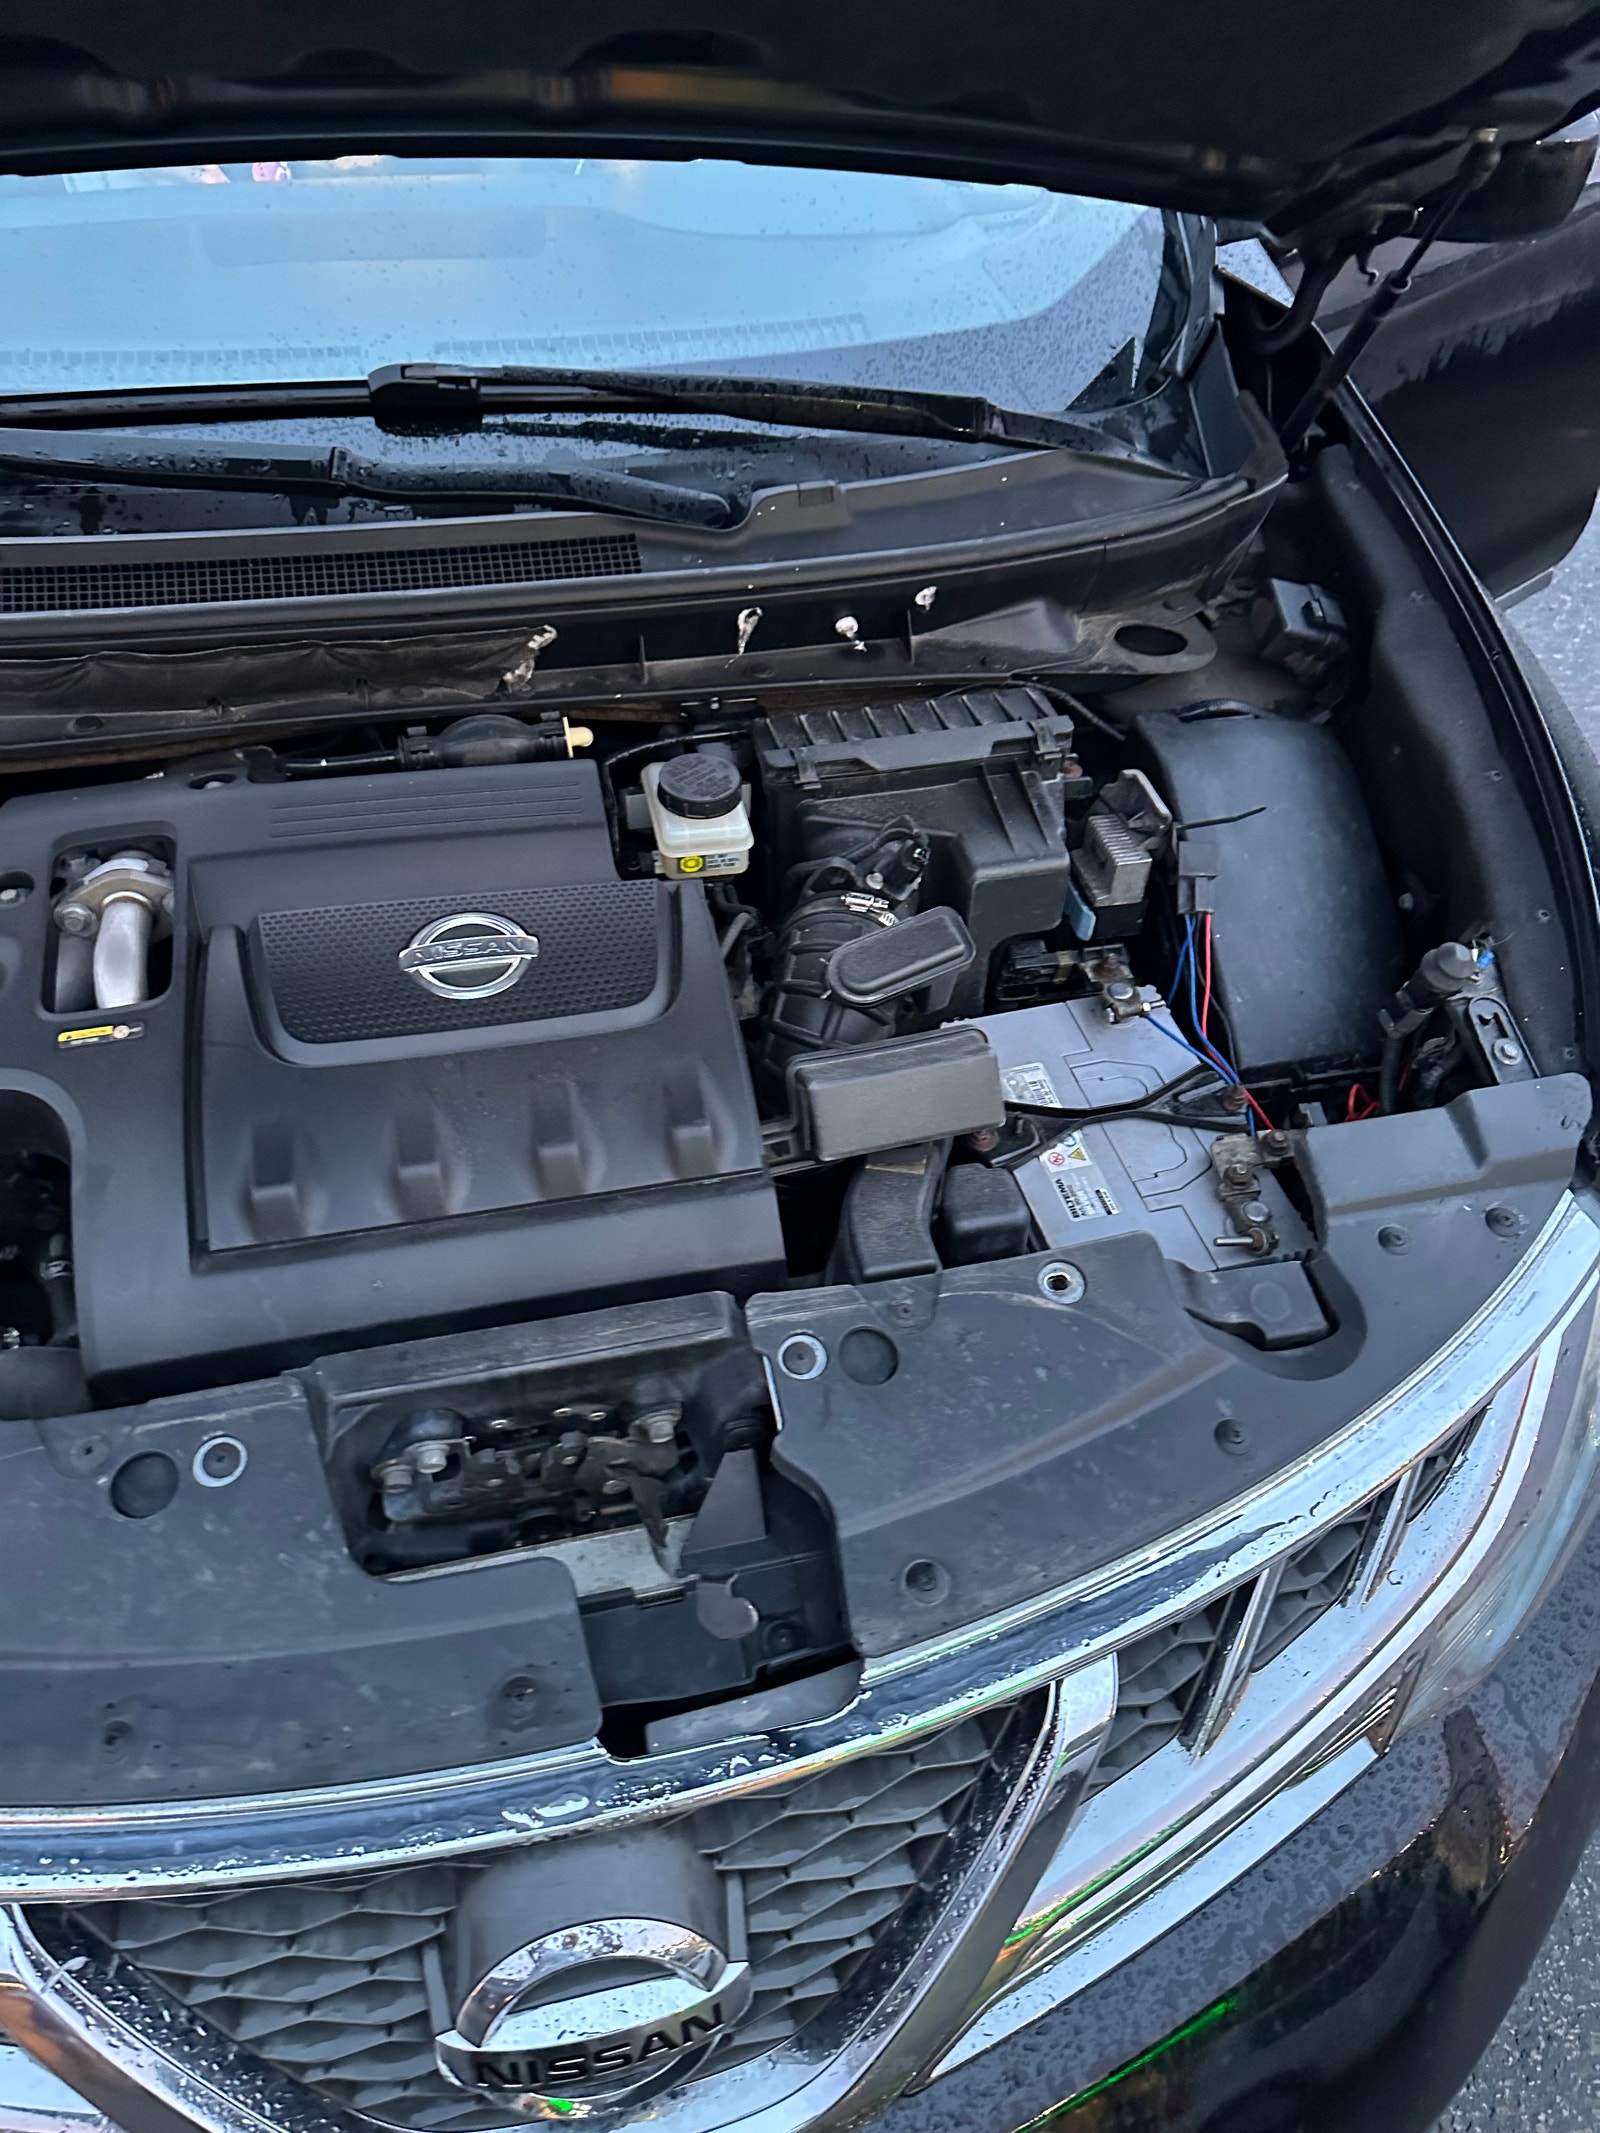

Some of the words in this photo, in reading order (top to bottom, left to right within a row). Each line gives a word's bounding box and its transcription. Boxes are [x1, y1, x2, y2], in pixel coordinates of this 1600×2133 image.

[412, 938, 526, 964] NISSAN
[1055, 1178, 1080, 1218] BILTEMA
[475, 2002, 726, 2089] NISSAN
